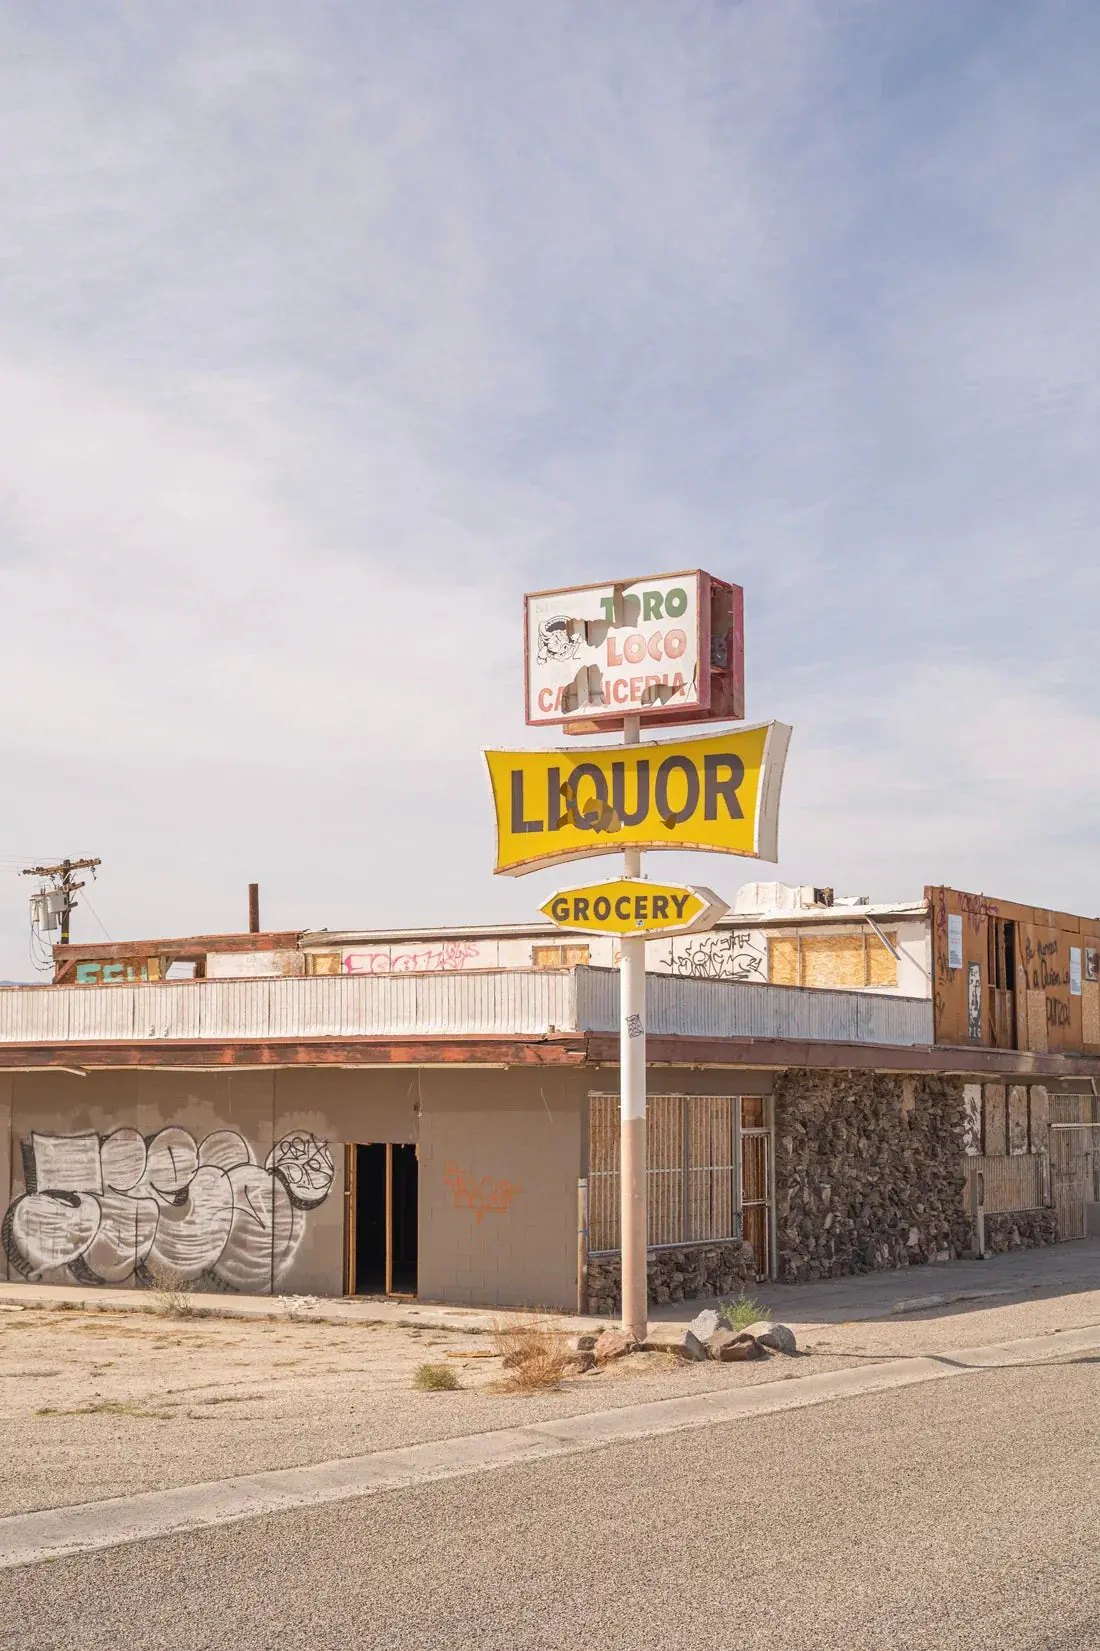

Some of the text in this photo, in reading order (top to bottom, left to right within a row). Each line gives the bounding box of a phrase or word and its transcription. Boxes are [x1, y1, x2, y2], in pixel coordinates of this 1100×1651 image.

[607, 629, 688, 667] LOCO
[511, 753, 744, 834] LIQUOR
[551, 894, 690, 922] GROCERY
